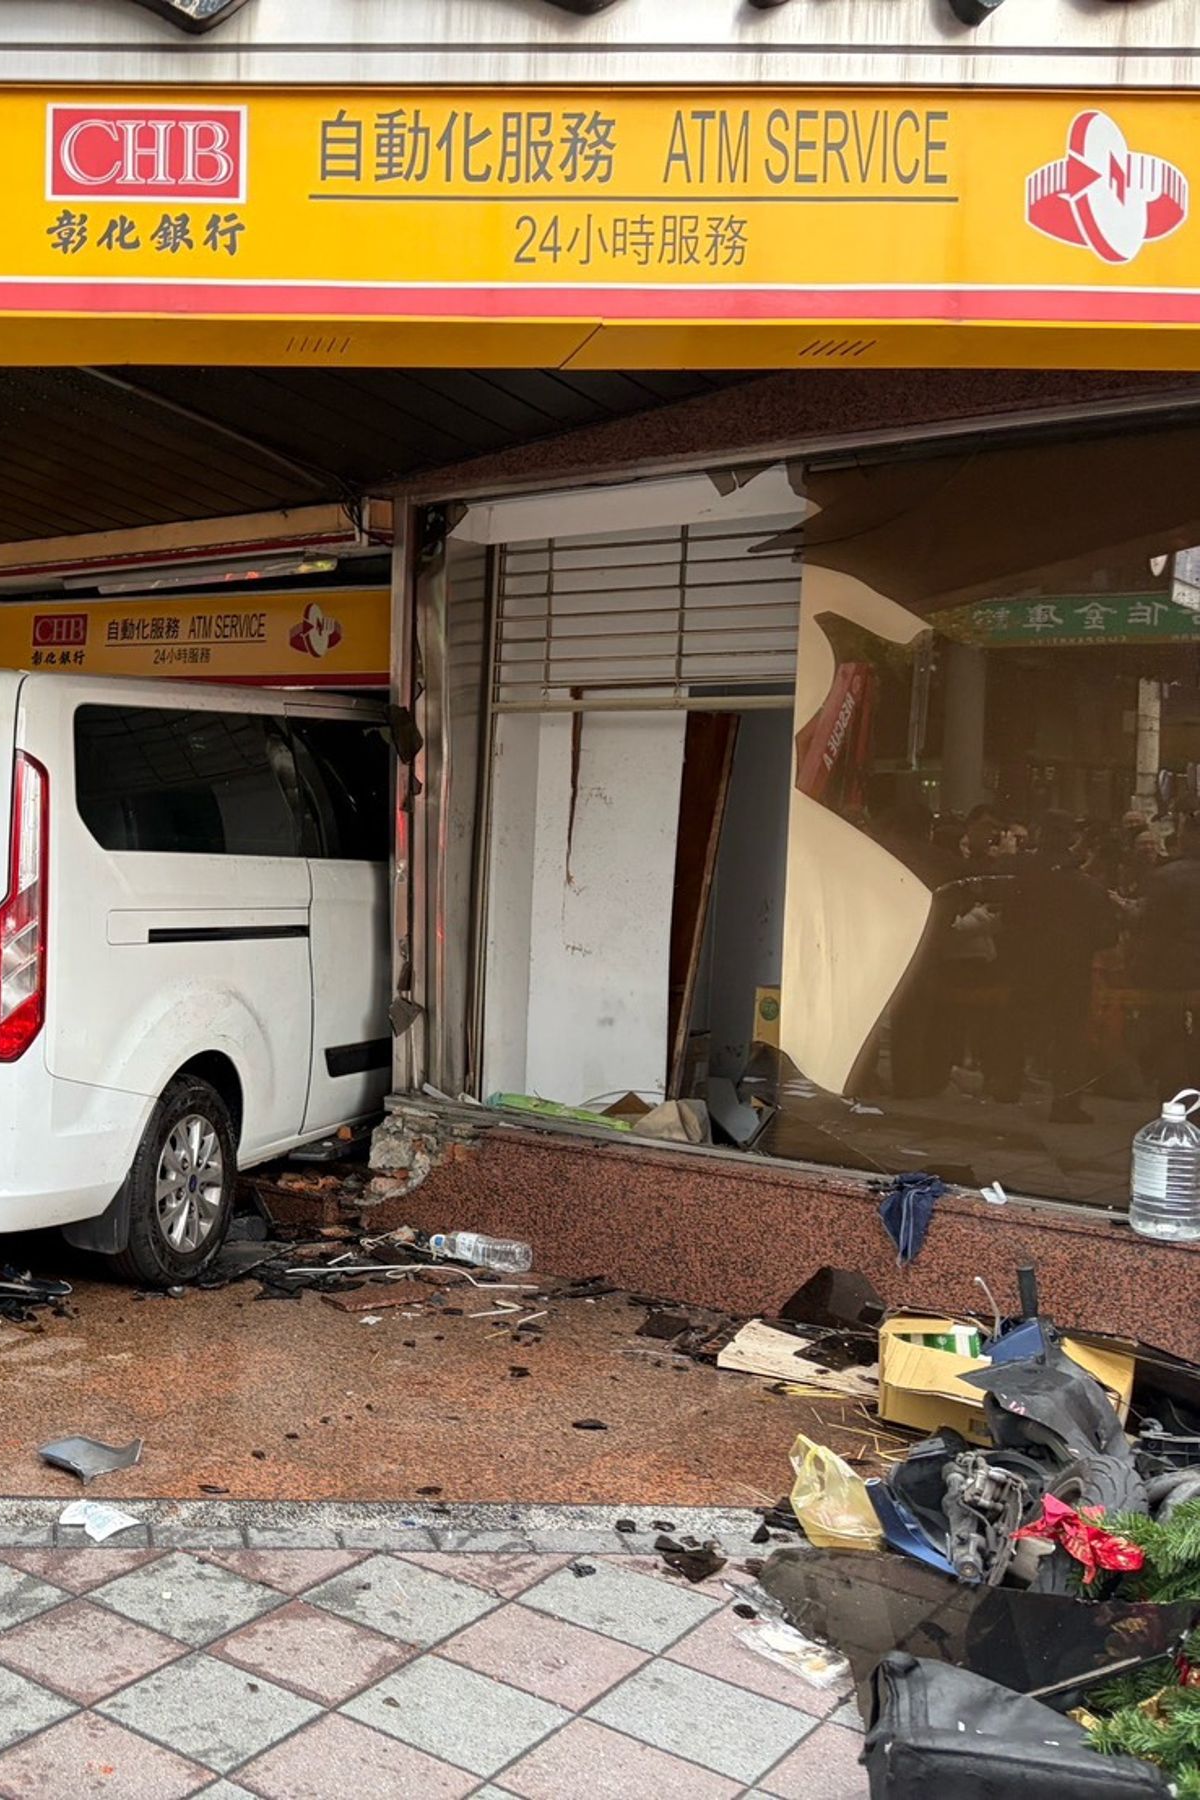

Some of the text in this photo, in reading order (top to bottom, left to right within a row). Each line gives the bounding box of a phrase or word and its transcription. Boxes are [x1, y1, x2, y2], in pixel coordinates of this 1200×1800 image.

[59, 119, 234, 187] CHB
[318, 109, 949, 185] 自動化服務 ATM SERVICE
[46, 209, 246, 257] 彰化銀行
[513, 215, 749, 267] 24小時服務
[34, 616, 85, 643] CHB
[107, 613, 267, 641] 自動化服務 ATM SERVICE
[31, 650, 85, 666] 彰化銀行
[153, 648, 211, 665] 24小時服務
